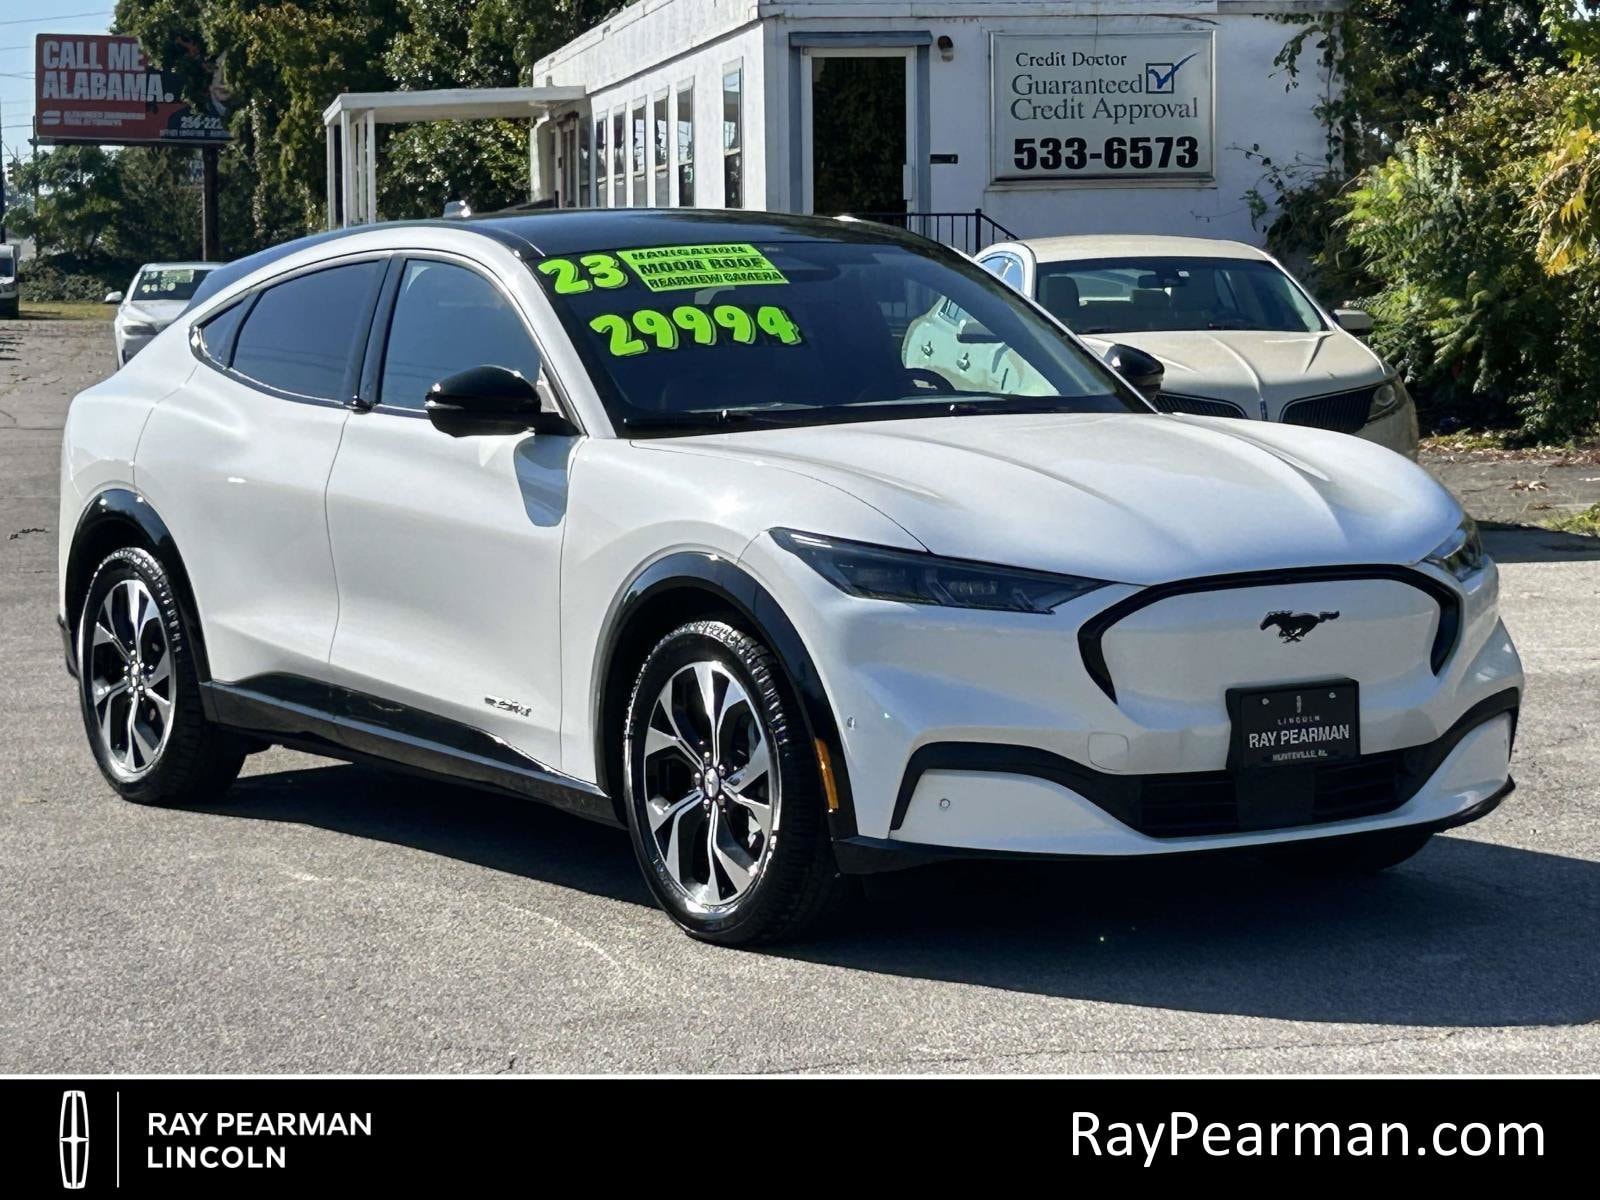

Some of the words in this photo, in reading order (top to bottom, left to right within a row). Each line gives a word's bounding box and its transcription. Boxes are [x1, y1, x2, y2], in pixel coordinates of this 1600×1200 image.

[42, 41, 103, 69] CALL
[108, 42, 145, 71] ME
[1015, 52, 1066, 67] Credit
[1072, 52, 1127, 67] Doctor
[42, 71, 174, 102] ALABAMA.
[1011, 74, 1143, 96] Guaranteed
[1010, 98, 1085, 121] Credit
[1092, 97, 1198, 125] Approval
[1013, 136, 1199, 170] 533-6573
[632, 245, 747, 260] NAVIGATION
[538, 254, 628, 295] 23
[637, 259, 707, 275] MOON
[708, 256, 766, 270] ROOF
[648, 274, 721, 288] REARVIEW
[724, 271, 784, 283] CAMERA
[589, 304, 803, 357] 29994
[1277, 715, 1320, 725] LINCOLN
[1249, 731, 1277, 748] RAY
[1280, 724, 1350, 745] PEARMAN
